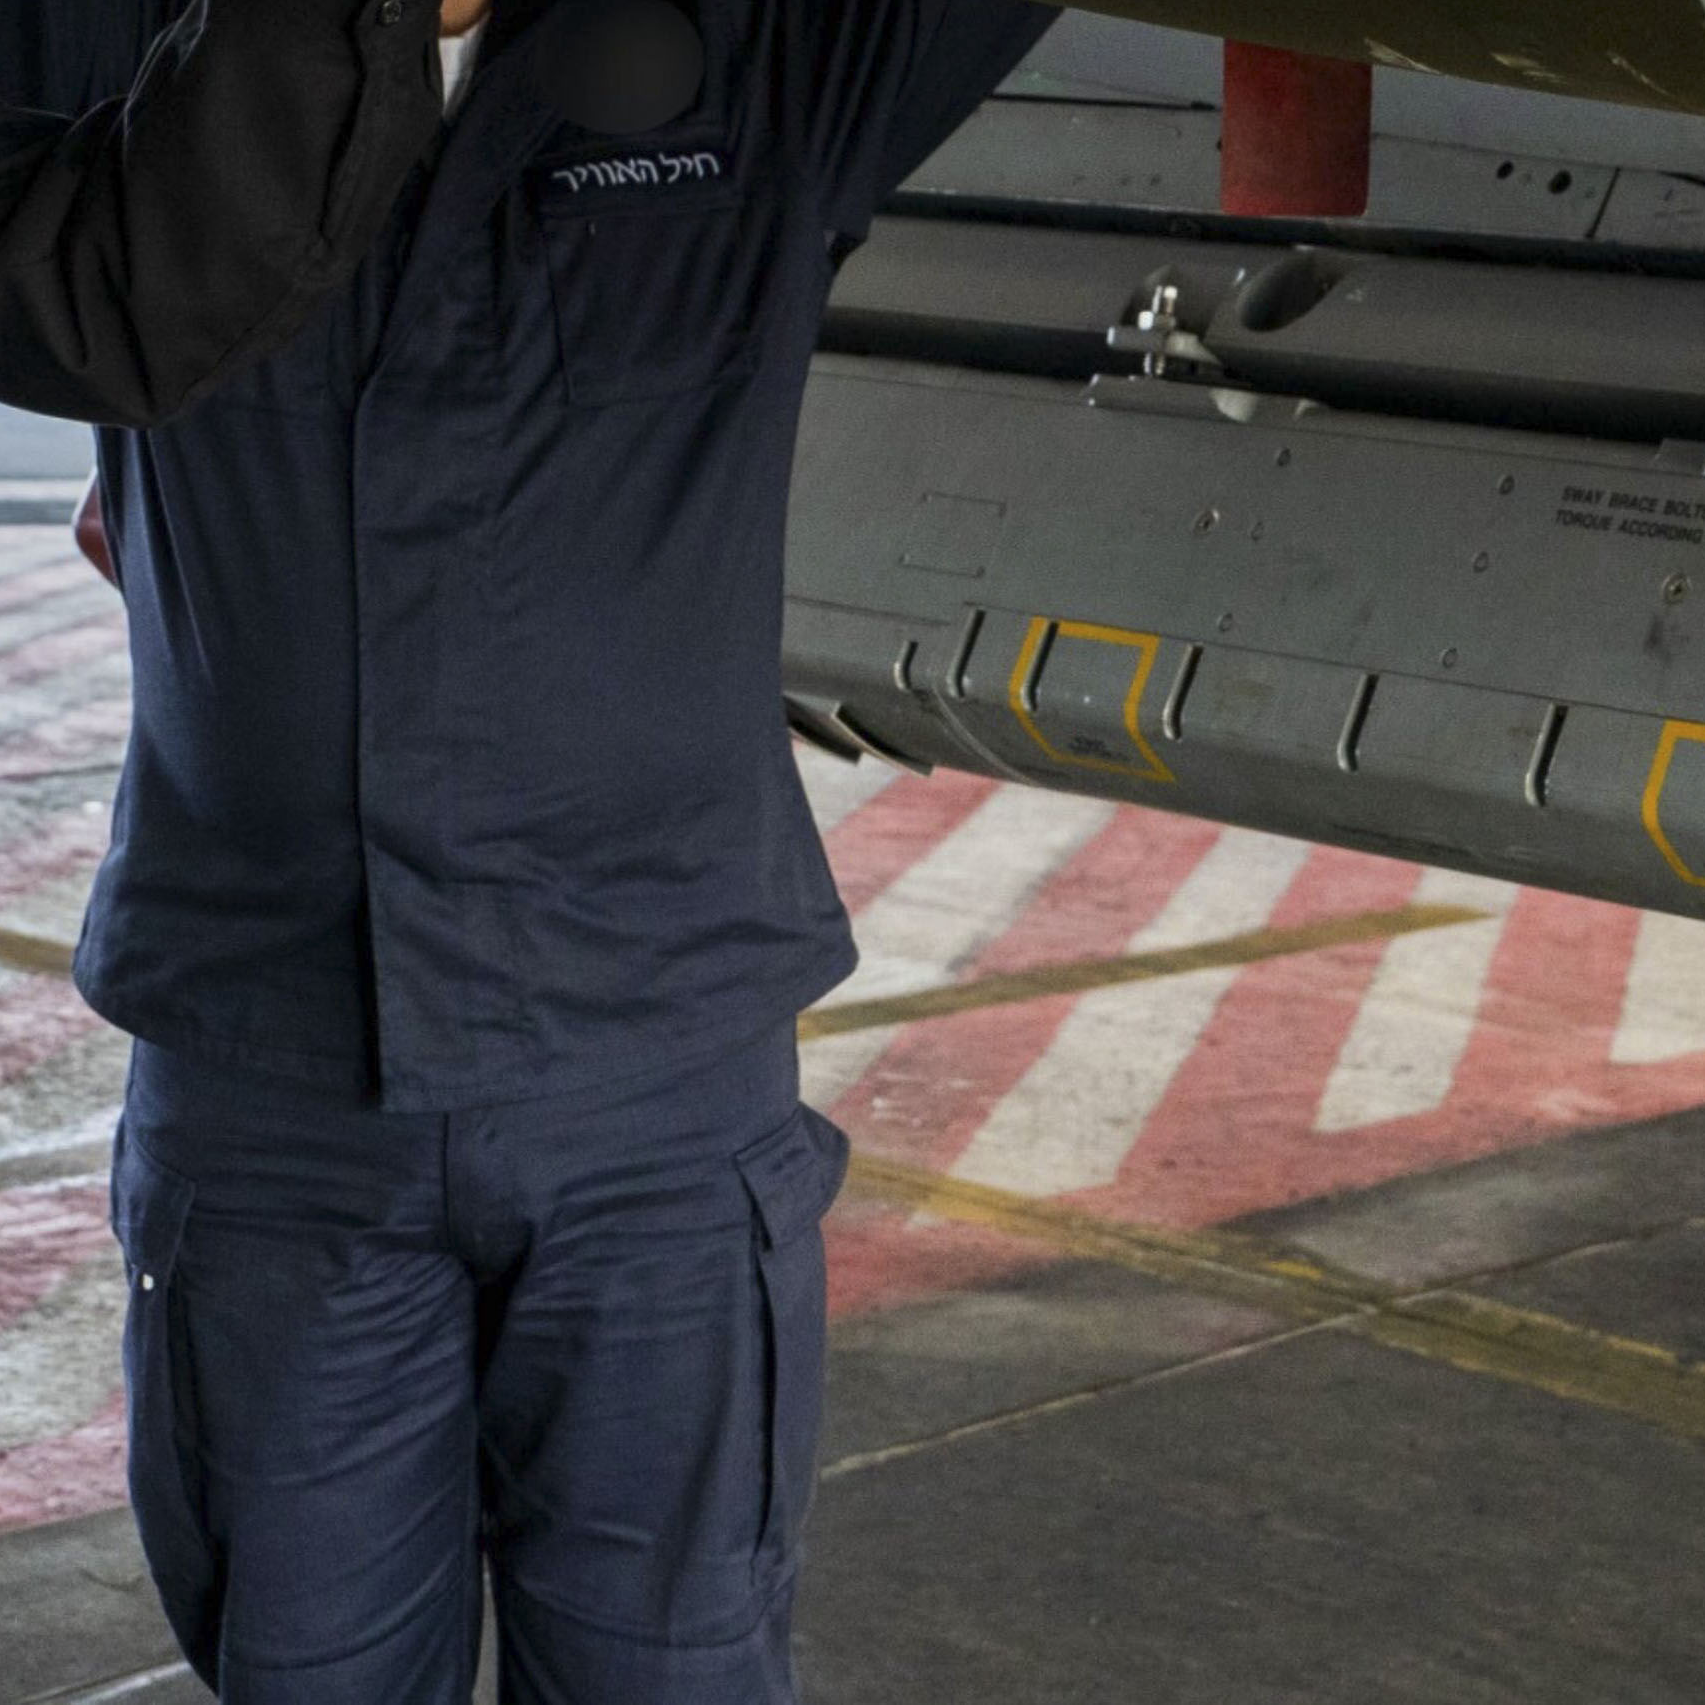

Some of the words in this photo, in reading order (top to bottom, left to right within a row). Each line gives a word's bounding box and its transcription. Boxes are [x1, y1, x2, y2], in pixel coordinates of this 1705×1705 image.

[551, 157, 659, 192] האוויר
[658, 152, 720, 184] חיל
[1608, 491, 1659, 514] BRACE
[1554, 509, 1614, 532] TORQUE
[1616, 518, 1704, 545] ACCORDING
